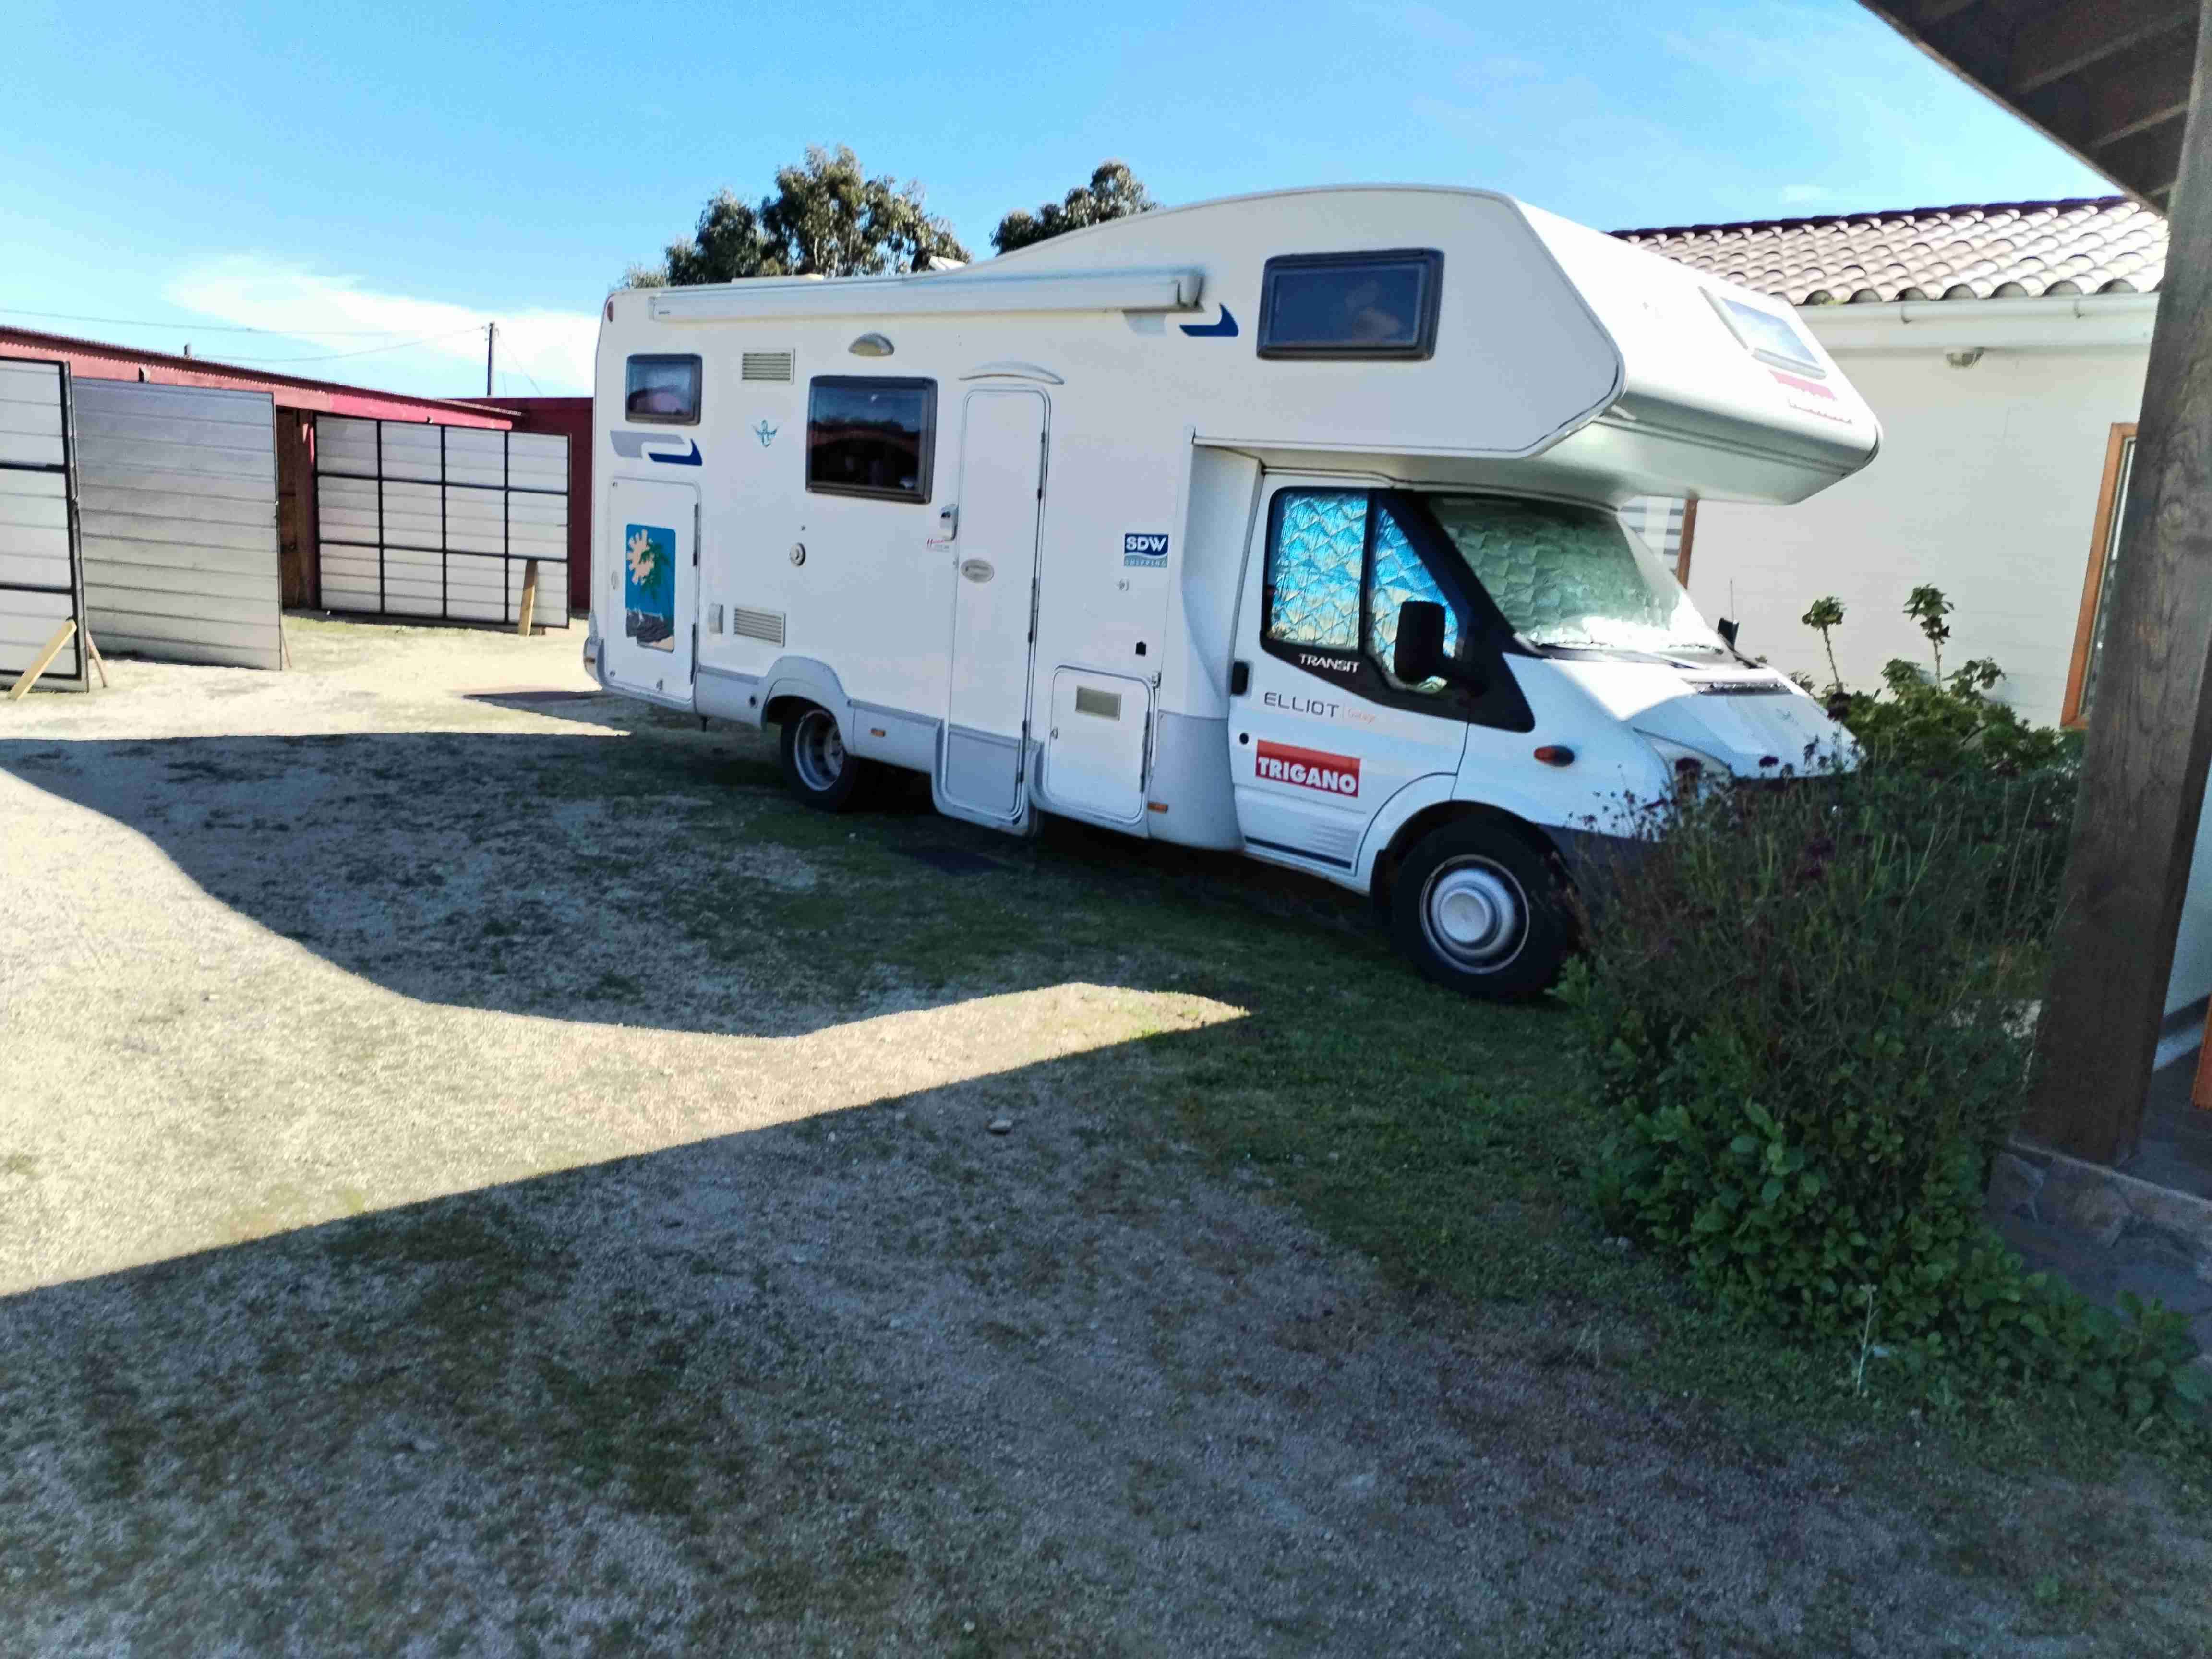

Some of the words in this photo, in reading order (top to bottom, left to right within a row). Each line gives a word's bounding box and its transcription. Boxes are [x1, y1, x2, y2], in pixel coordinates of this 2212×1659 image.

[1126, 536, 1166, 551] SDW
[1298, 653, 1360, 673] TRANSIT
[1264, 691, 1339, 718] ELLIOT
[1258, 757, 1357, 793] TRIGANO
